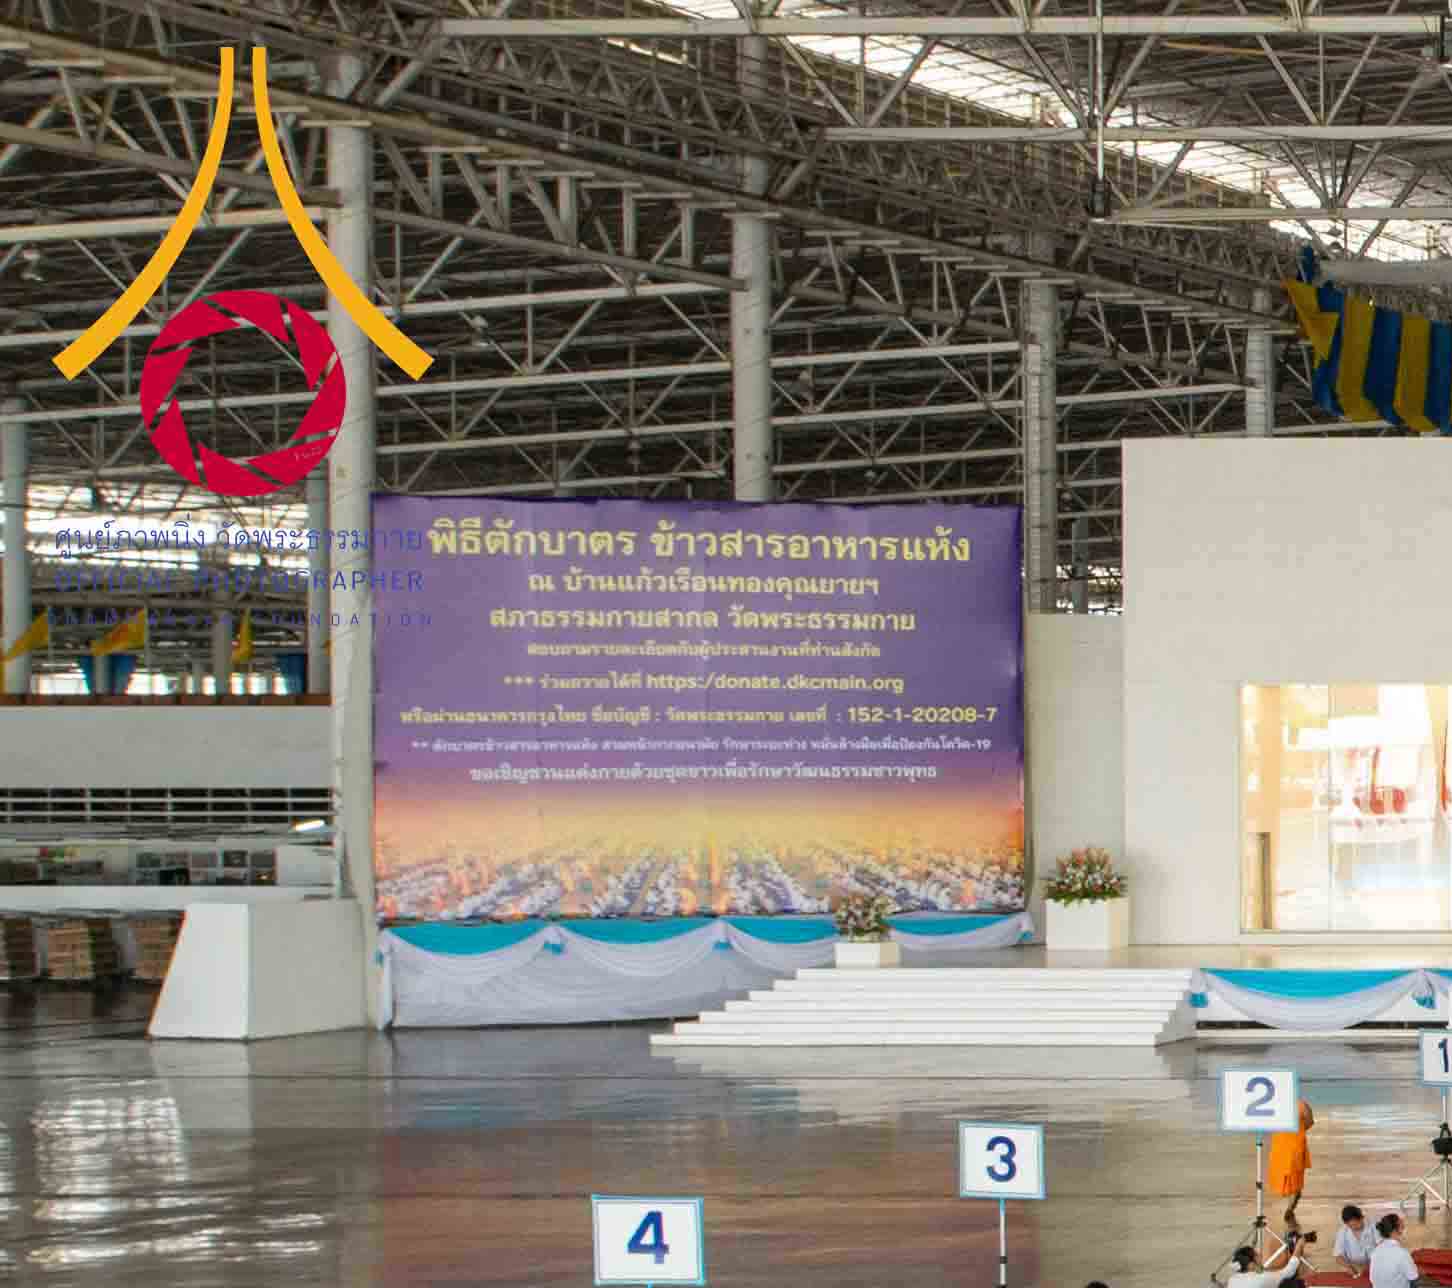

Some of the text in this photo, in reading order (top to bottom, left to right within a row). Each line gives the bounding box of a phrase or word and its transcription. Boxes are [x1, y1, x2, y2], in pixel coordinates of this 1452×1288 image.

[426, 516, 971, 562] พิธีตักบาตร ข้าวสารอาหารแห้ง
[490, 603, 917, 632] สภาธรรมกายสากล วัดพระธรรมกาย
[847, 706, 998, 723] 152-1-20208-7
[1437, 1038, 1449, 1073] 1
[1244, 1076, 1276, 1117] 2
[986, 1135, 1017, 1183] 3
[627, 1210, 670, 1265] 4
